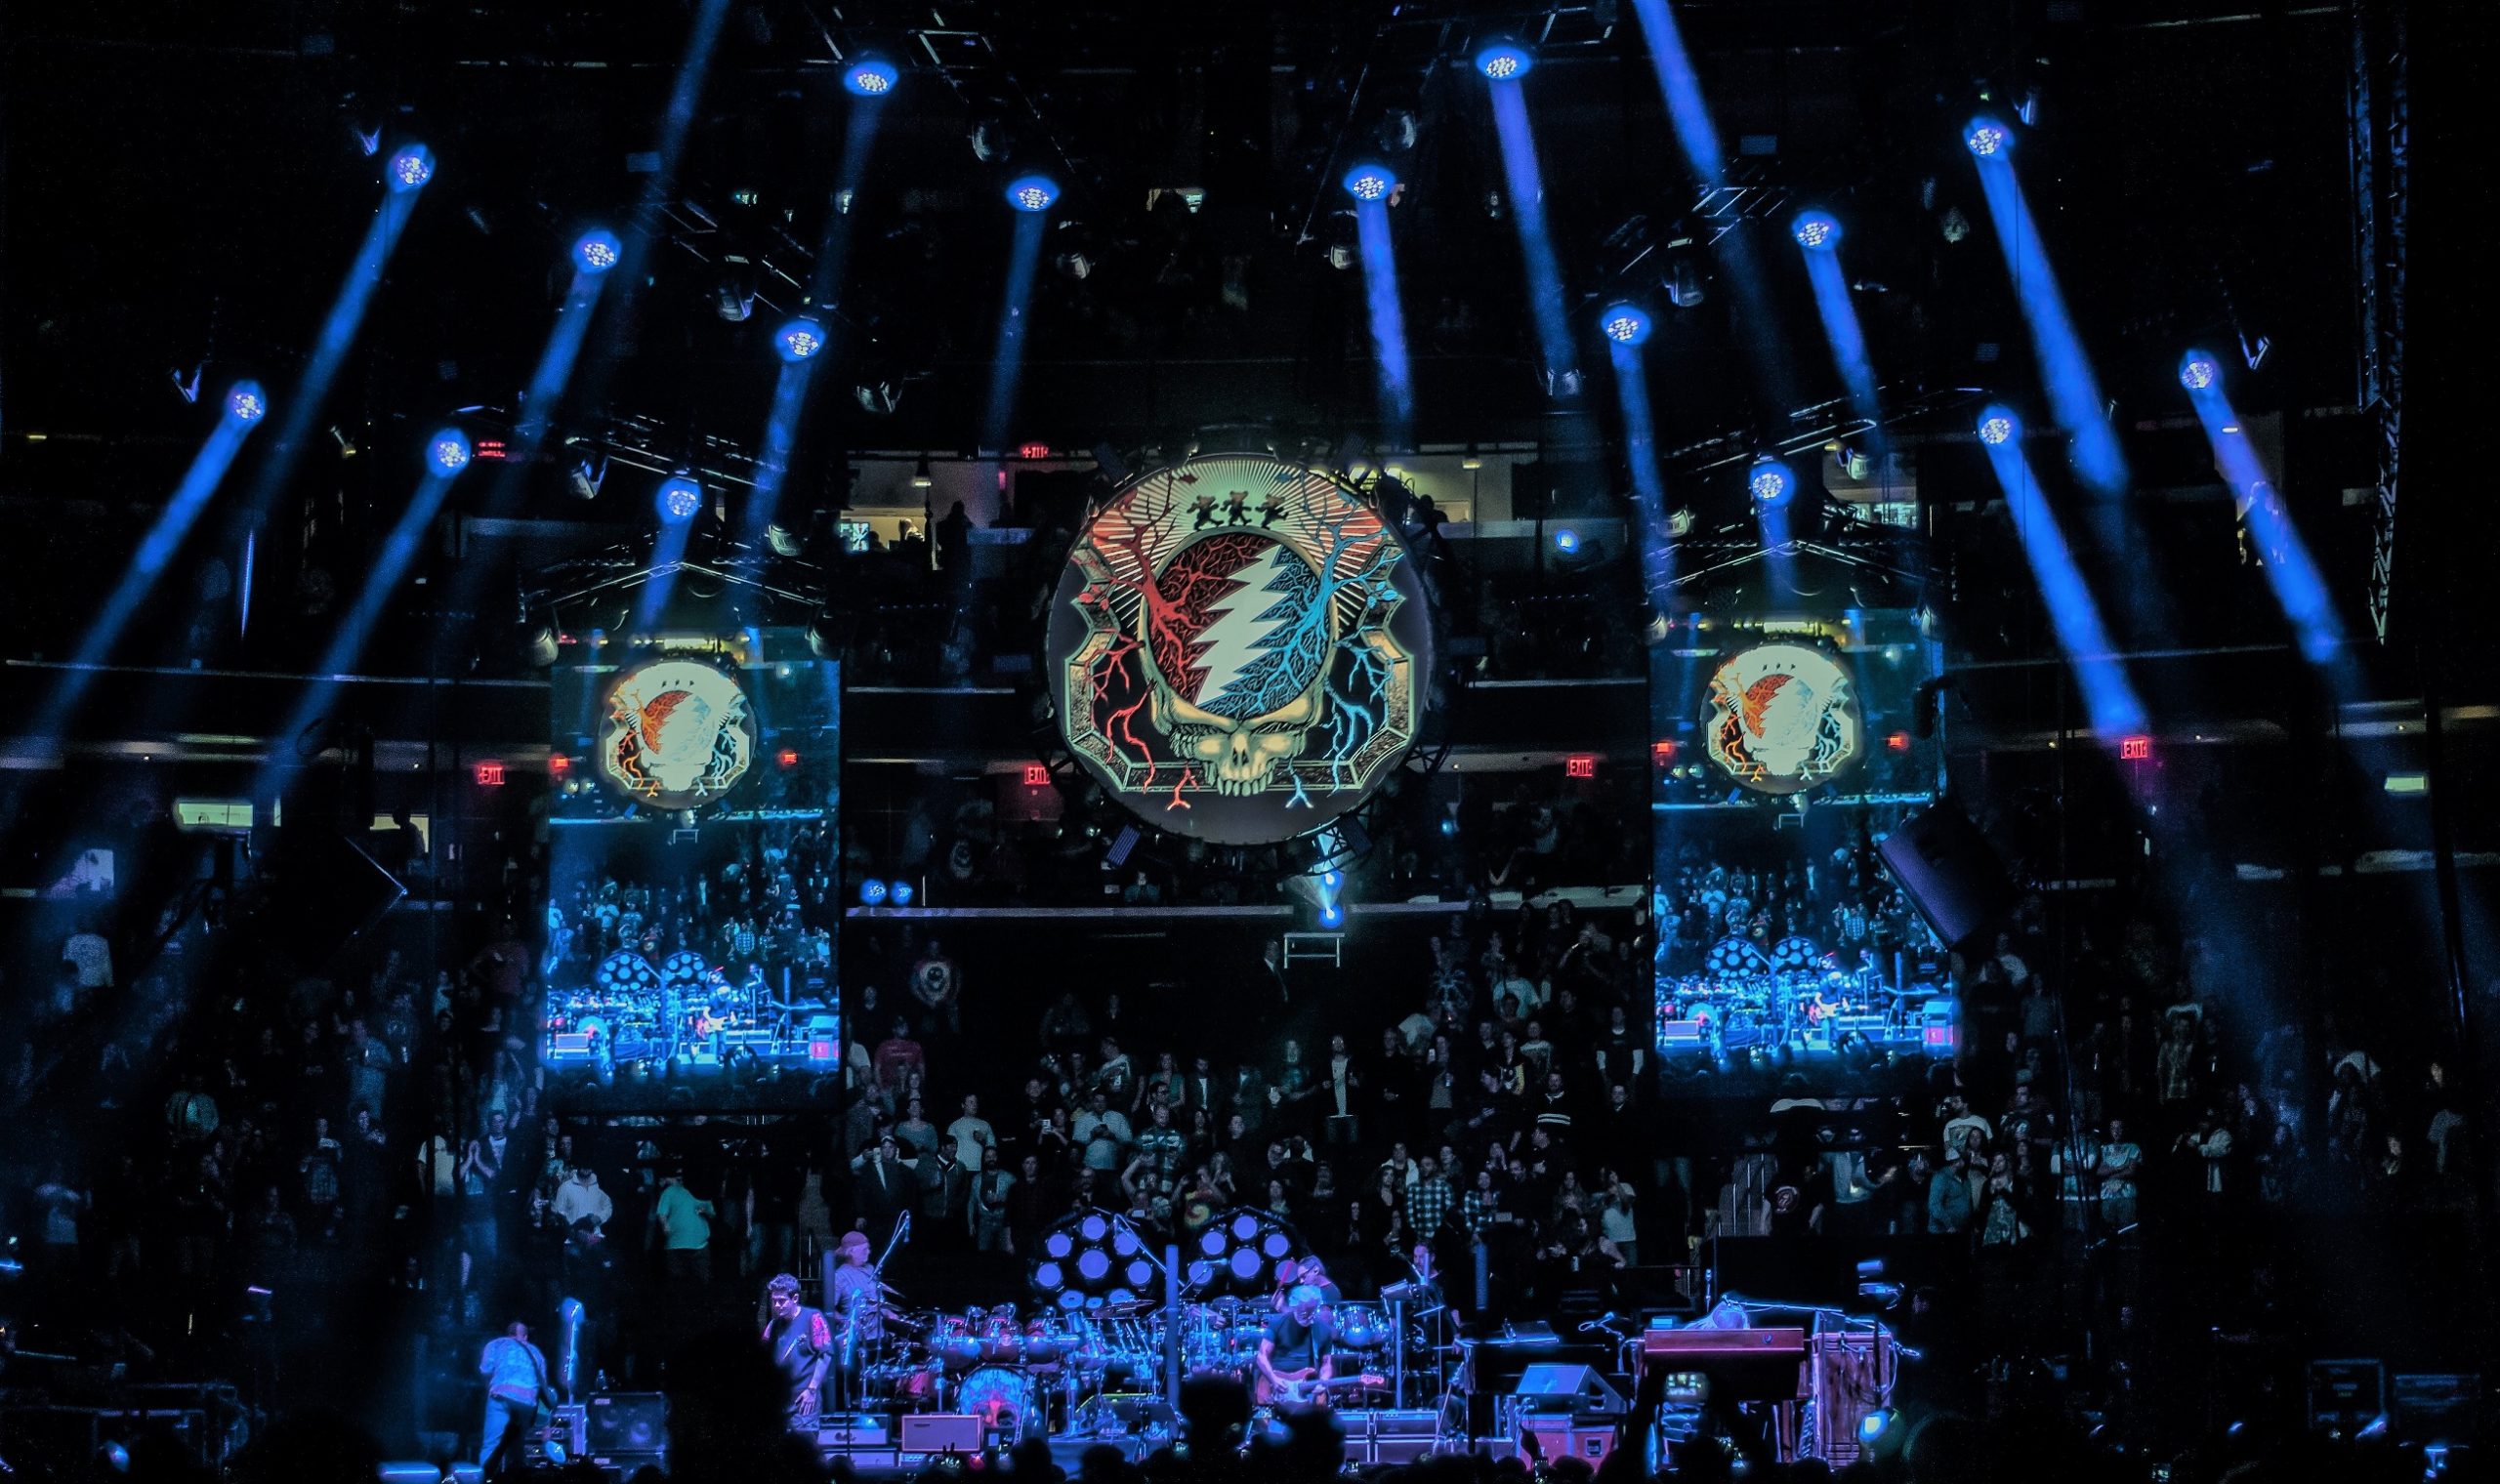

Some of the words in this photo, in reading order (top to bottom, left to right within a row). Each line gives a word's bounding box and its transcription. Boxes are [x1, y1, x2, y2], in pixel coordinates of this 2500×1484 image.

[2124, 739, 2146, 758] EXIT
[481, 766, 503, 783] EXIT
[1027, 766, 1047, 783] EXIT
[1569, 759, 1591, 776] EXIT
